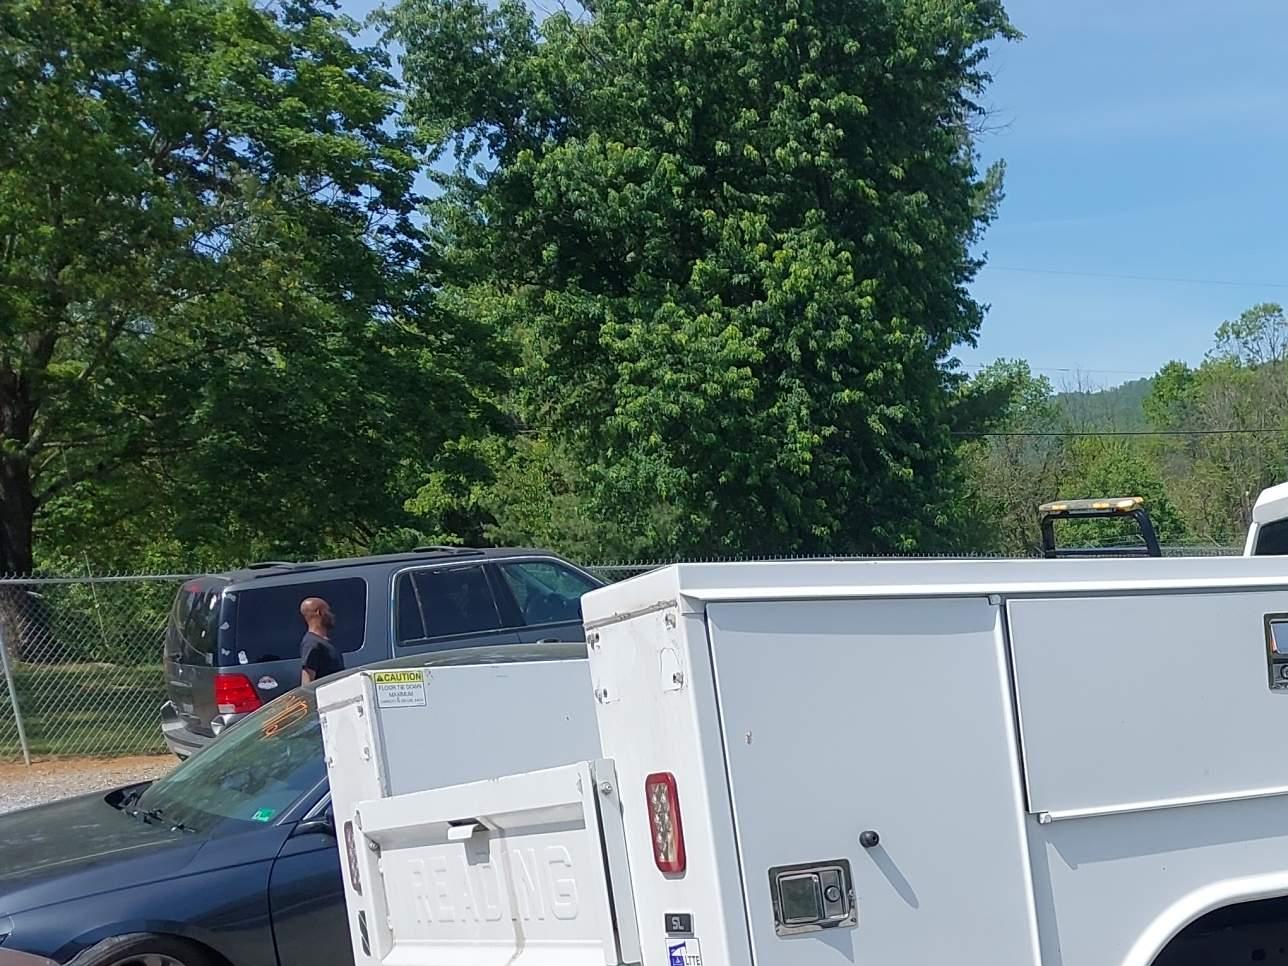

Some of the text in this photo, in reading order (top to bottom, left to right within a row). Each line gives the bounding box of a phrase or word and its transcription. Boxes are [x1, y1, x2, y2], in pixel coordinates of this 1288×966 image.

[384, 673, 422, 682] CAUTION
[407, 845, 579, 923] READING
[671, 916, 685, 930] SL
